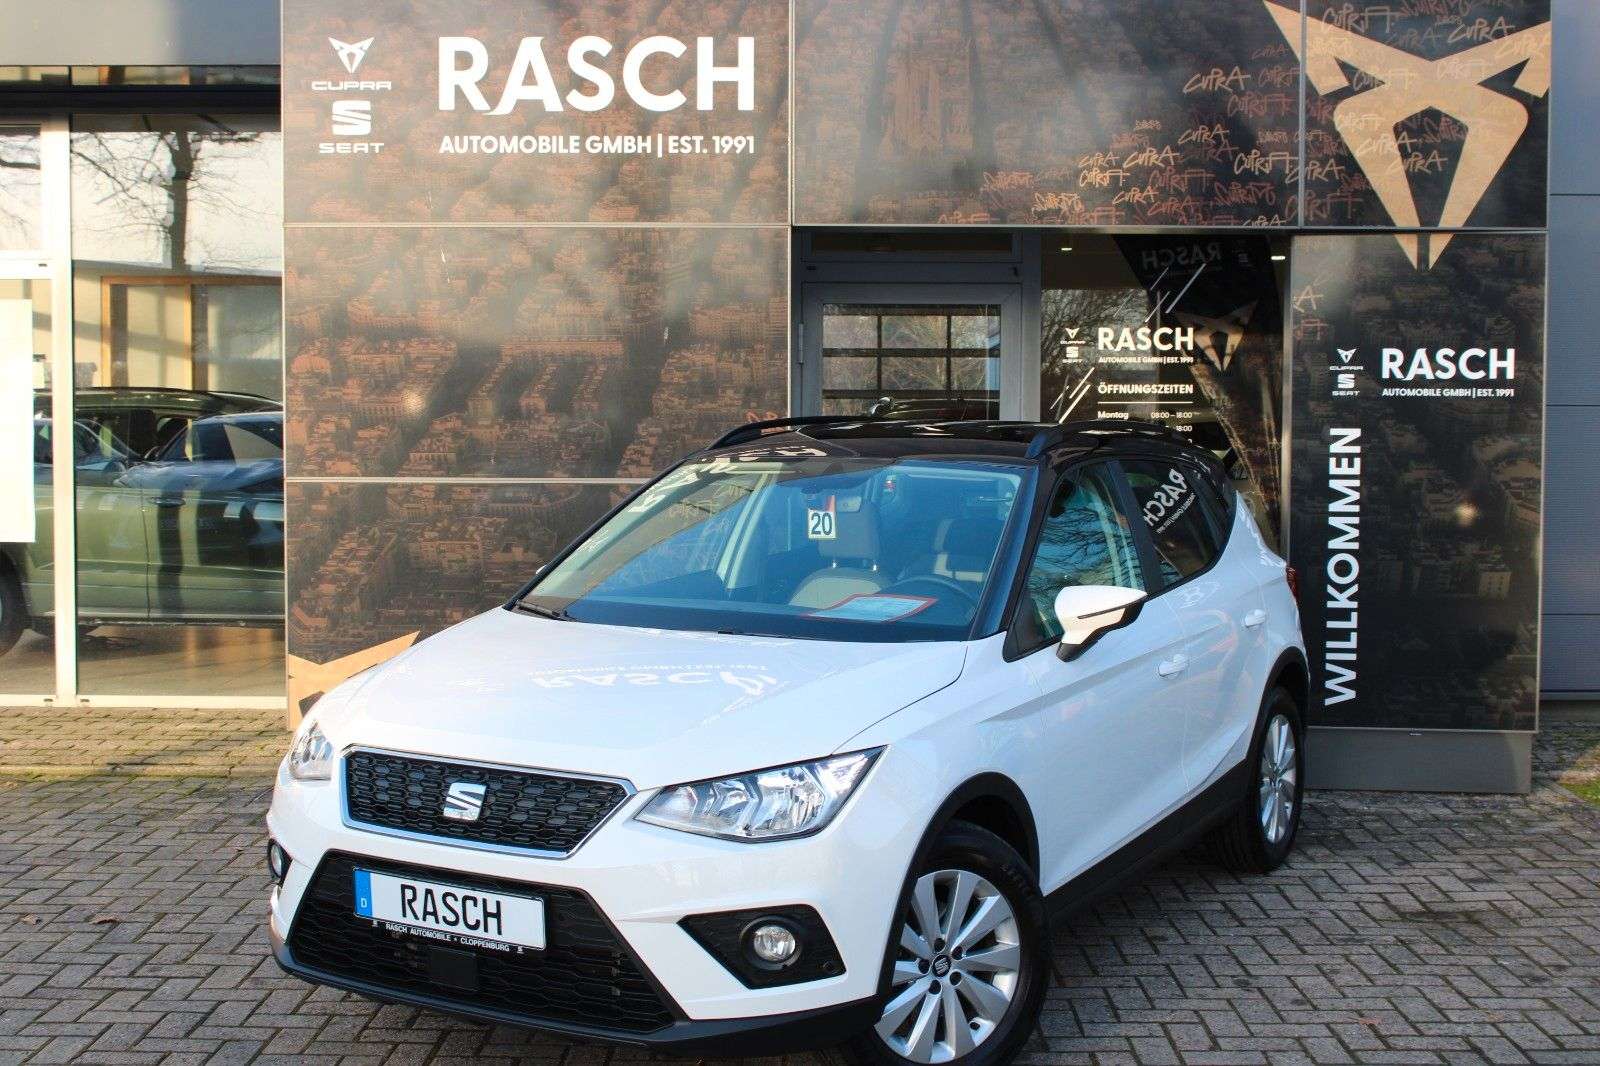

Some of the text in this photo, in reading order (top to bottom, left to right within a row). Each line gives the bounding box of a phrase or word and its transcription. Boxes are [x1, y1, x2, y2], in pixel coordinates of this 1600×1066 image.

[1448, 16, 1515, 43] CUPRA
[311, 81, 391, 90] CUPRA
[438, 35, 755, 116] RASCH
[1183, 65, 1250, 94] CUPRA
[439, 135, 580, 154] AUTOMOBILE
[585, 135, 652, 154] GMBH
[668, 135, 708, 154] EST.
[712, 135, 755, 154] 1991
[1177, 124, 1229, 146] CUPRA
[318, 142, 384, 154] SEAT
[1122, 145, 1180, 169] CUPRA
[1112, 185, 1159, 205] CUPRA
[1097, 327, 1194, 351] RASCH
[1098, 356, 1141, 364] AUTOMOBILE
[1382, 348, 1516, 380] RASCH
[1098, 382, 1194, 394] ÖFFNUNGSZEITEN
[1382, 388, 1442, 397] AUTOMOBILE
[1442, 388, 1472, 397] GMBH
[1496, 388, 1514, 397] 1991
[1097, 411, 1129, 420] Montag
[811, 512, 833, 536] 20
[1325, 428, 1362, 706] WILLKOMMEN
[400, 883, 503, 936] RASCH
[386, 922, 510, 952] RASCH AUTOMOBILE CLOPPENBURG
